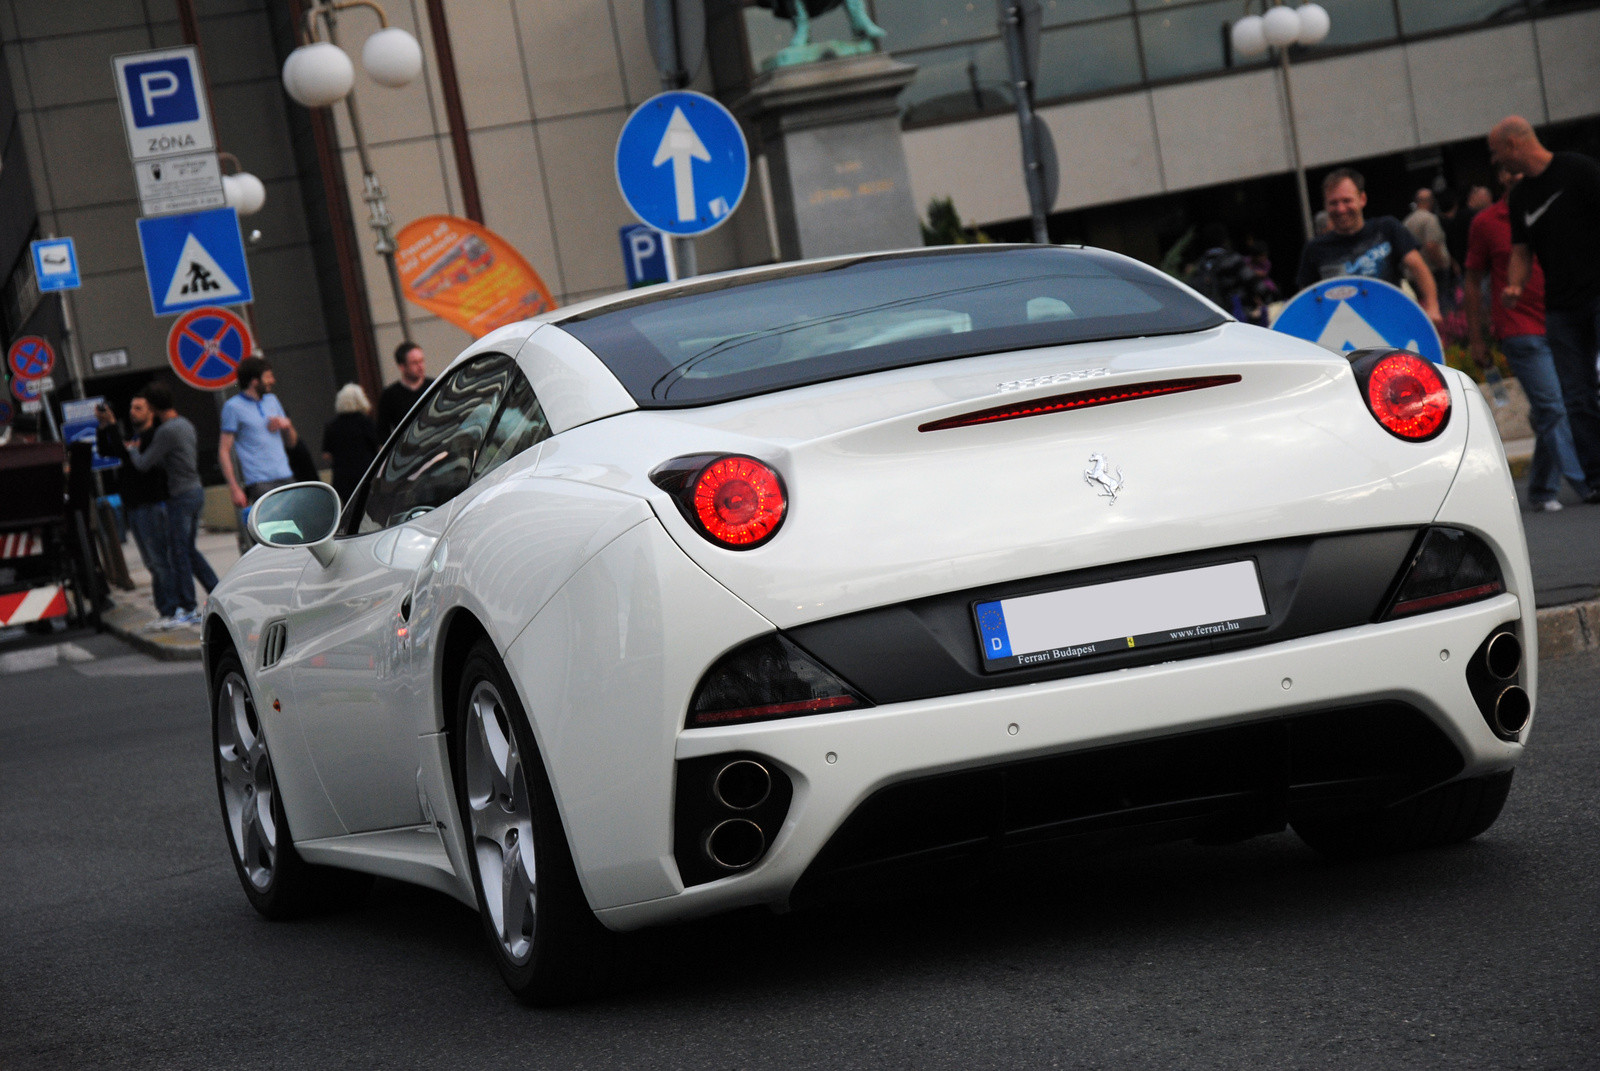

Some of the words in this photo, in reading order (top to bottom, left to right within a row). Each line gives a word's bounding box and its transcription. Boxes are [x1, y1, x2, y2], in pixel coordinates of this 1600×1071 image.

[140, 70, 179, 117] P
[630, 235, 656, 281] P
[1170, 621, 1240, 639] www.ferrari.hu
[991, 637, 1003, 651] D
[1018, 651, 1051, 664] Ferrari
[1053, 644, 1096, 660] Budapest
